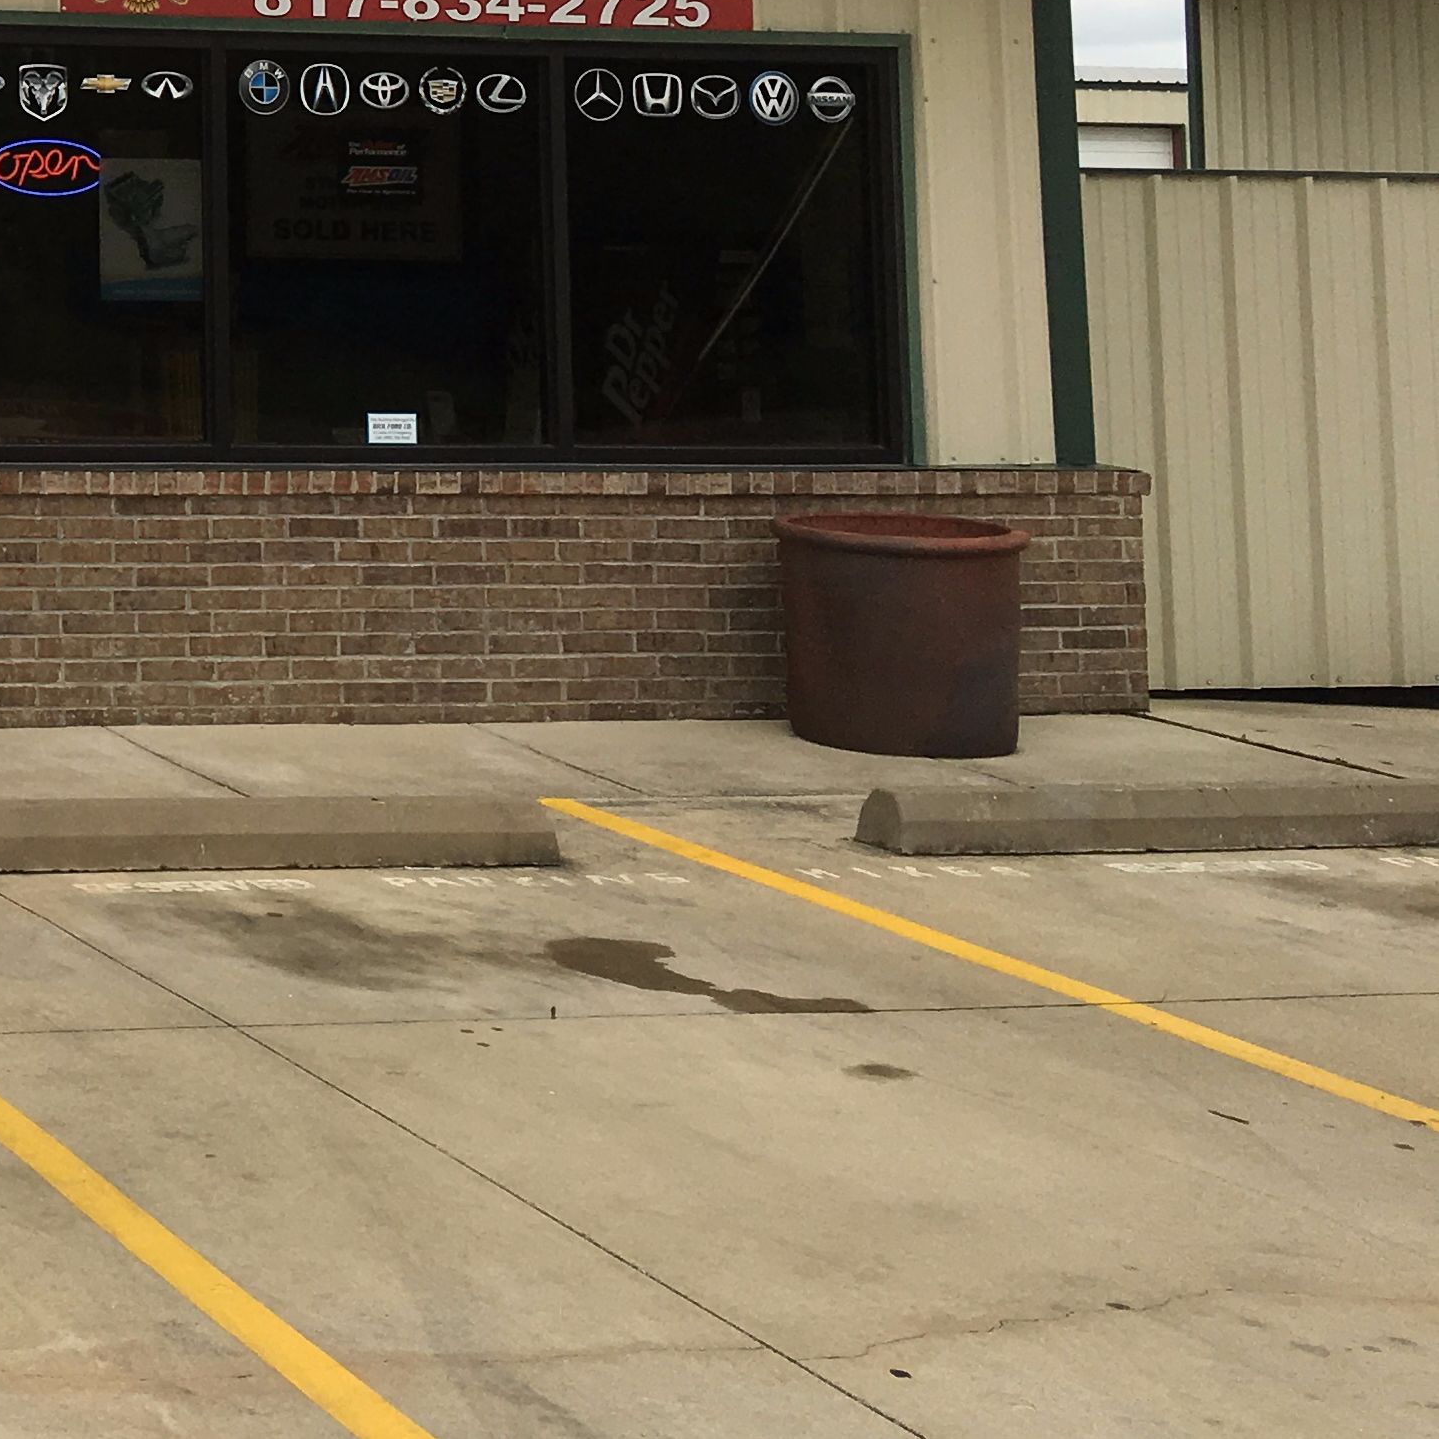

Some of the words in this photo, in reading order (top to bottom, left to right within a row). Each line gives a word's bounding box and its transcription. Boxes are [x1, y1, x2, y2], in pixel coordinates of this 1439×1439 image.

[810, 95, 852, 104] NISSAN
[342, 166, 418, 186] AMSOIL
[273, 218, 351, 241] SOLD
[361, 219, 437, 243] HERE
[73, 878, 316, 893] RESERVED
